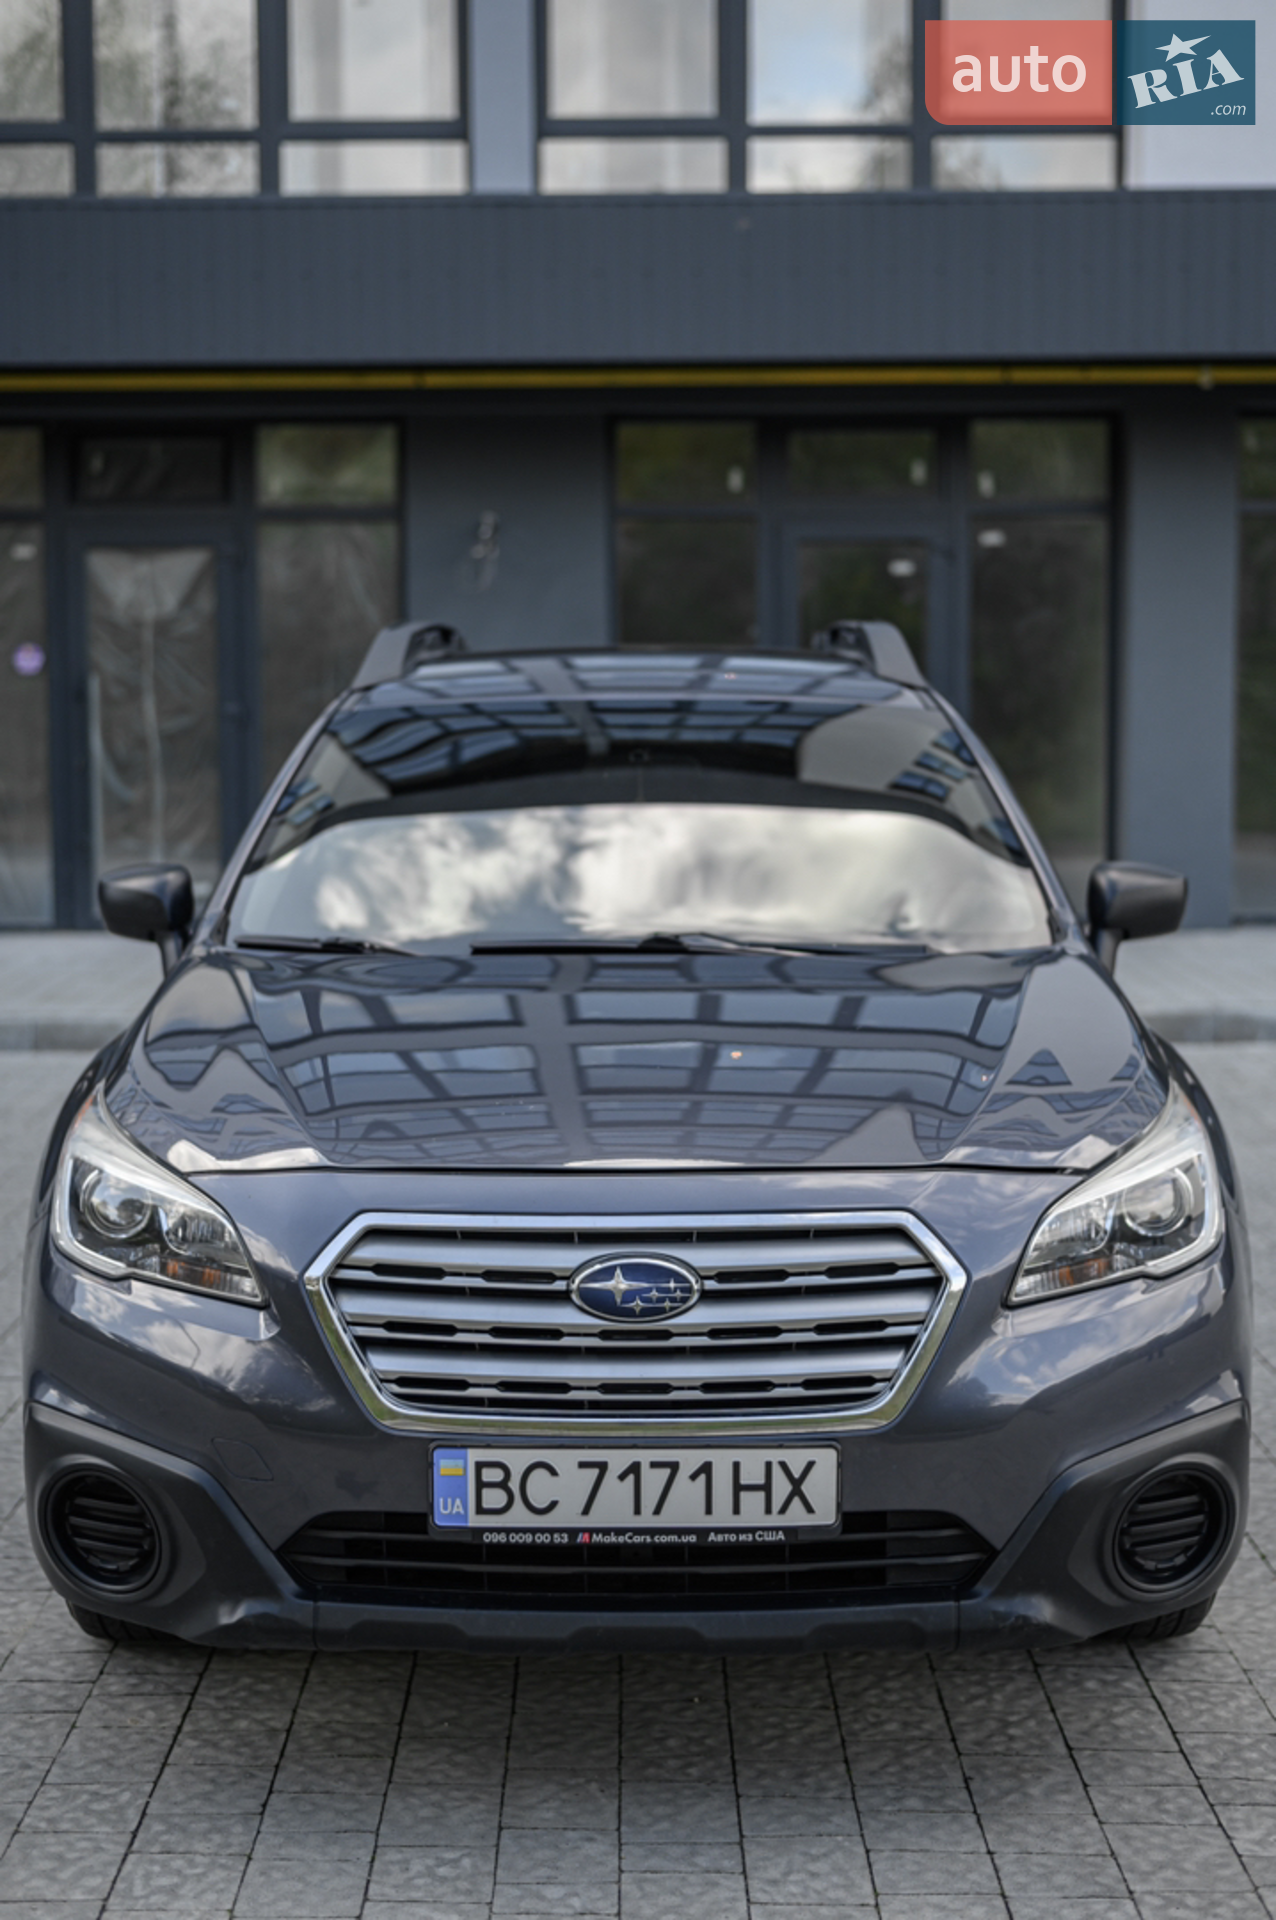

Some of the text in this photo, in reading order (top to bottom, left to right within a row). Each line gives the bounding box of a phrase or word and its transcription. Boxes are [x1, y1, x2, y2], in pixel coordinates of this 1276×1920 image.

[475, 1461, 816, 1516] BC 7171 HX
[440, 1497, 464, 1515] UA
[483, 1532, 568, 1543] 096 009 00 53
[708, 1530, 785, 1542] Авто из США
